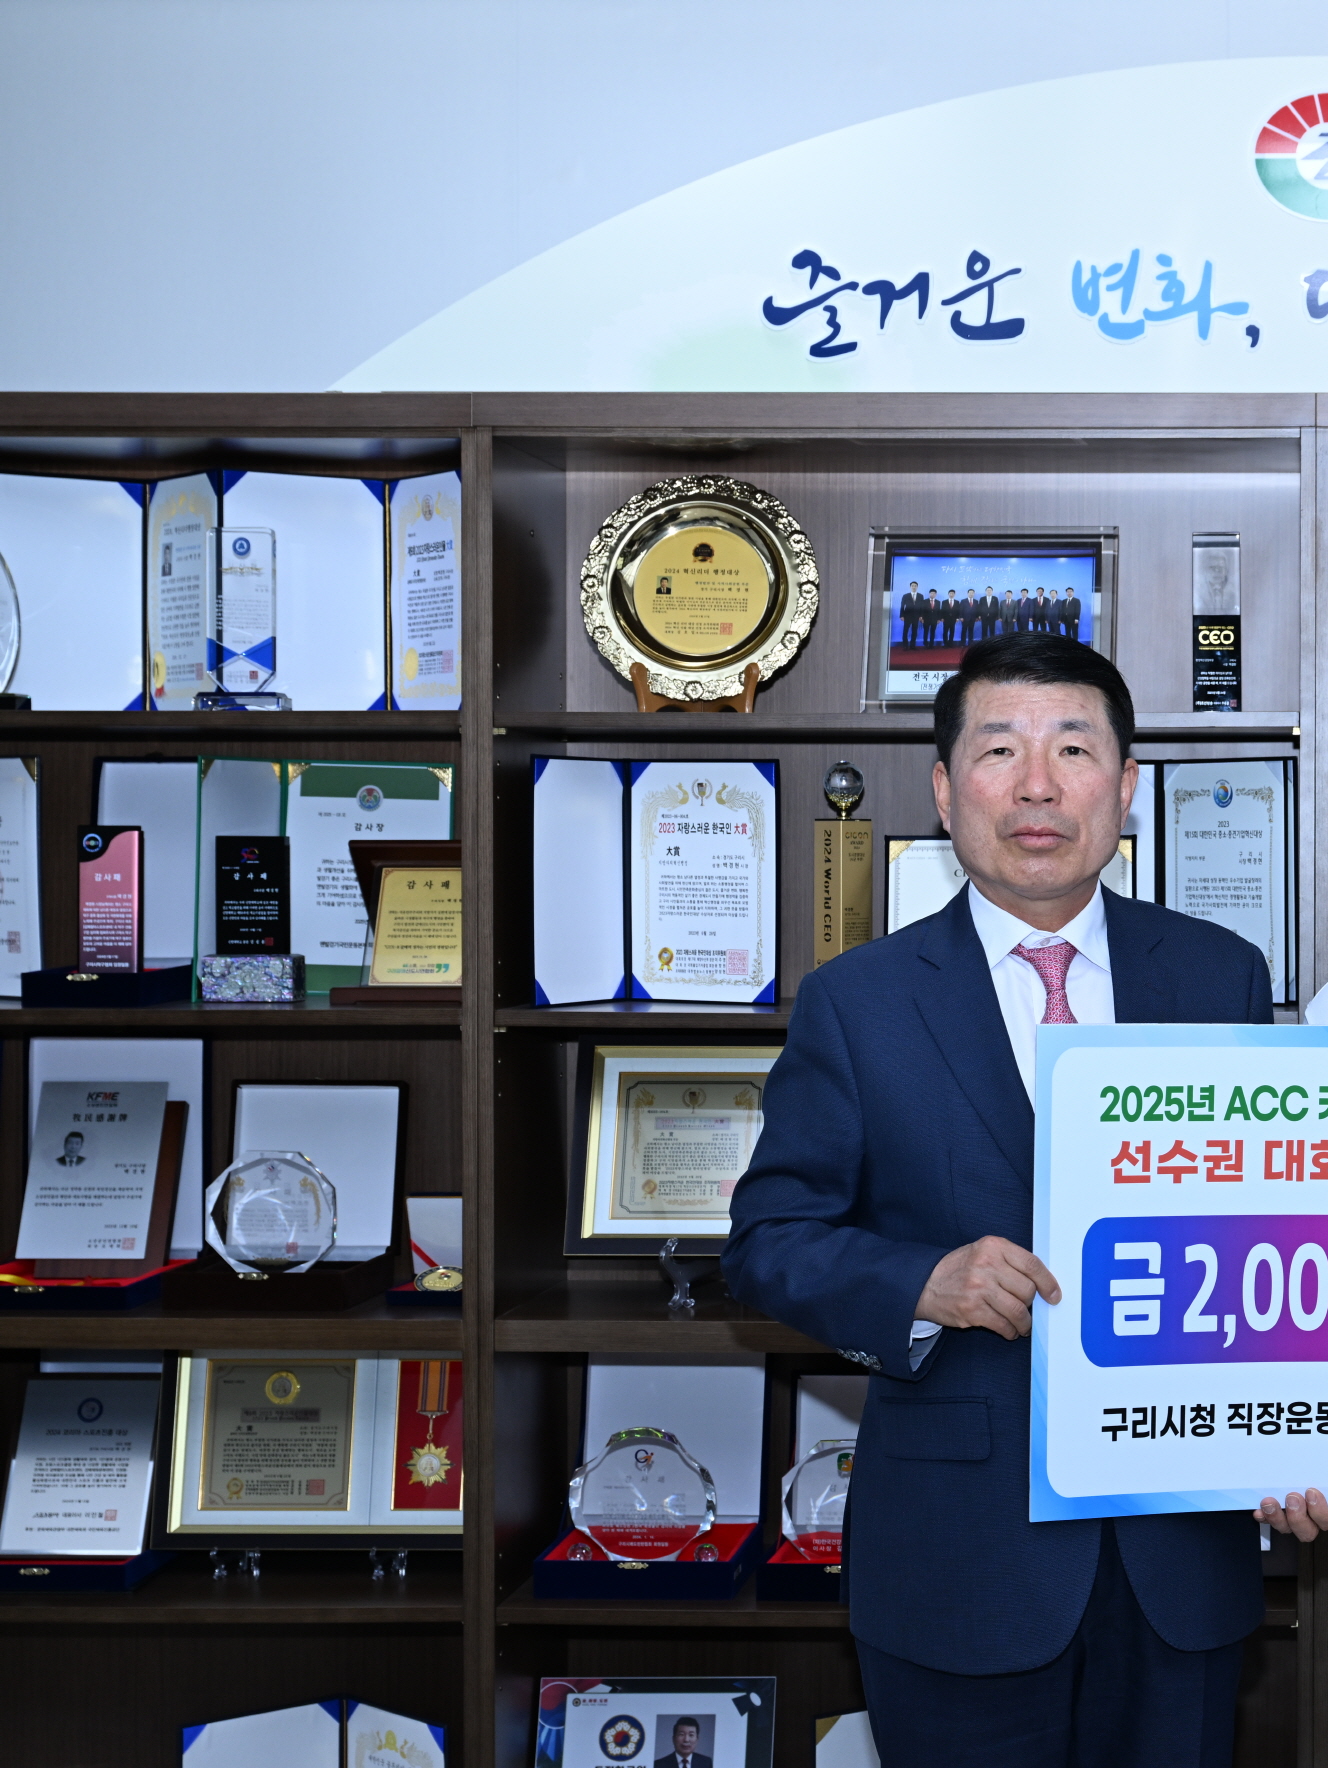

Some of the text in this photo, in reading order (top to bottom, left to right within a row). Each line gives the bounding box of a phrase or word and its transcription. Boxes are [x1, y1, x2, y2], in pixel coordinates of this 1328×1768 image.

[762, 249, 1025, 359] 즐거운
[1072, 248, 1260, 348] 변화,
[1198, 630, 1234, 644] CEO
[354, 823, 384, 832] 감사장
[659, 822, 675, 833] 2023
[677, 822, 710, 834] 자랑스러운
[712, 822, 732, 834] 한국인
[1199, 830, 1216, 839] 대한민국
[823, 829, 832, 864] 2024
[406, 880, 450, 890] 감사패
[823, 916, 832, 943] CEO
[87, 1092, 120, 1101] KFME
[1099, 1084, 1216, 1122] 2025년
[1224, 1084, 1309, 1122] ACC
[1110, 1140, 1245, 1184] 선수권
[1109, 1241, 1166, 1336] 금
[1101, 1404, 1217, 1442] 구리시청
